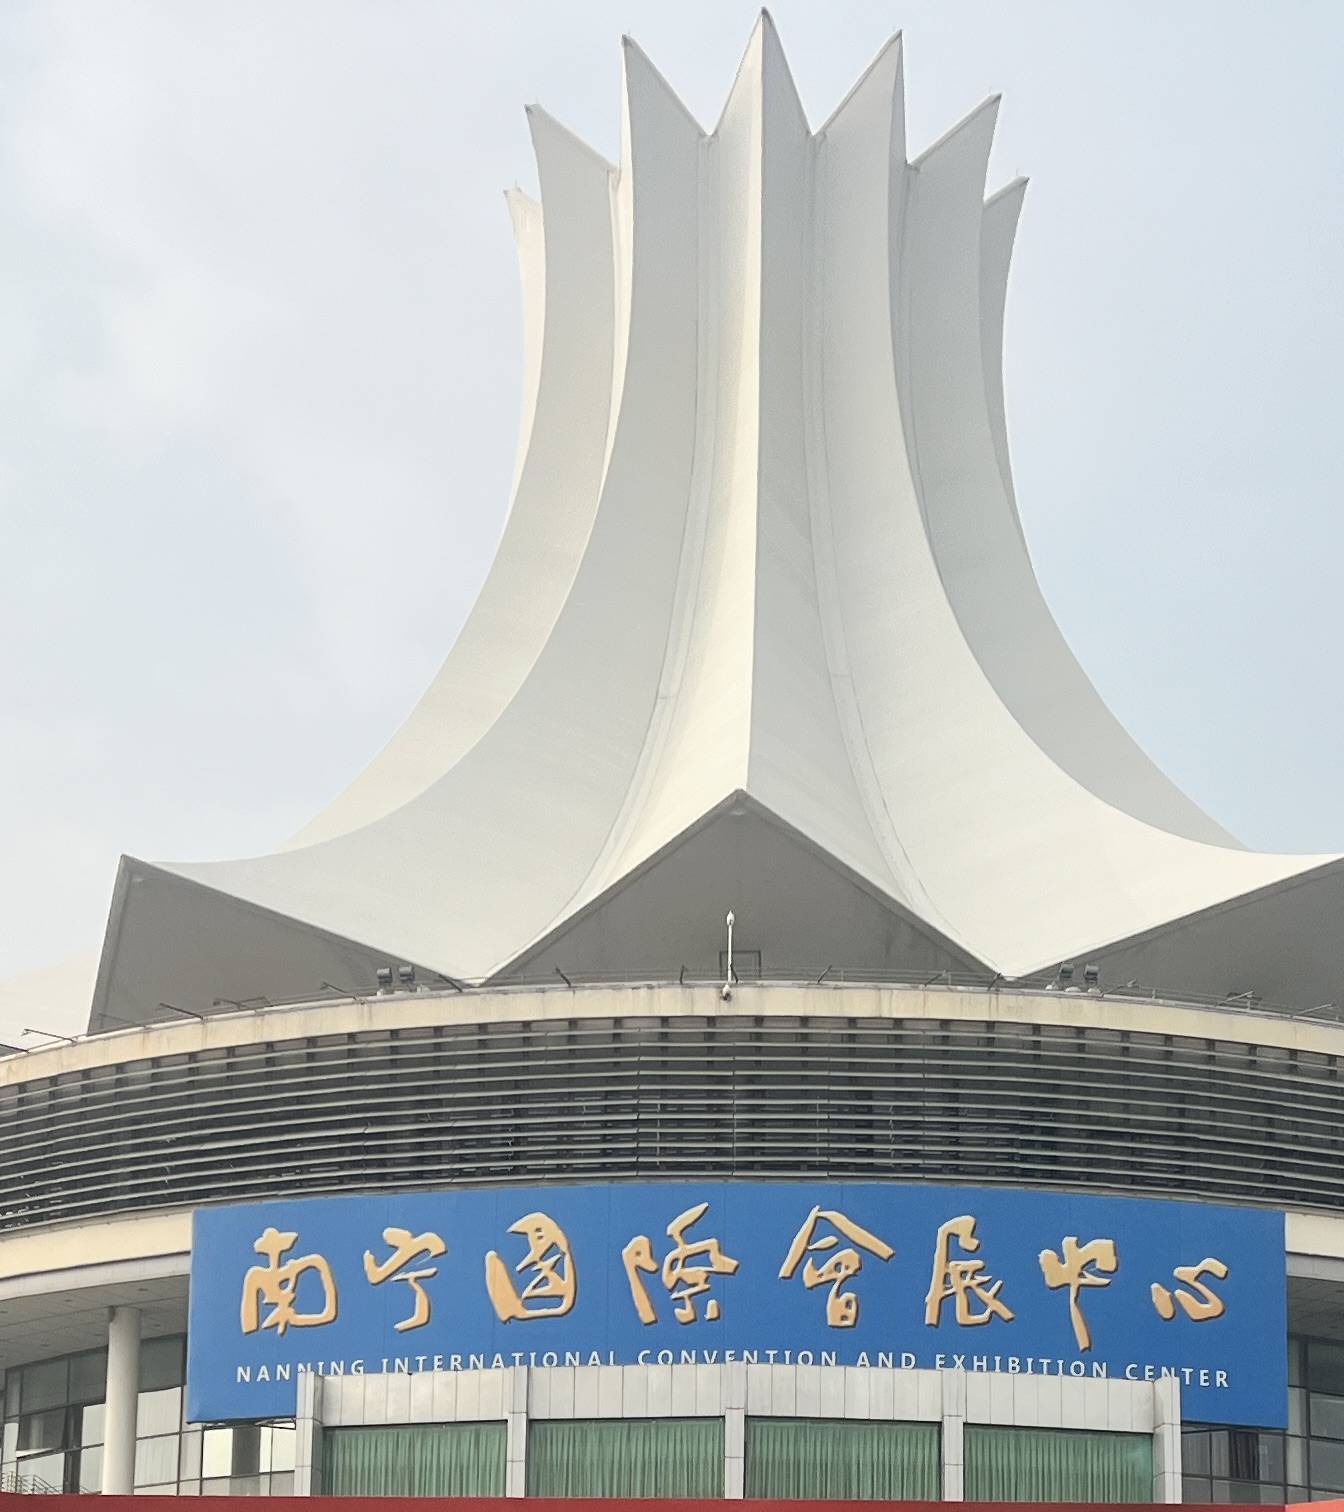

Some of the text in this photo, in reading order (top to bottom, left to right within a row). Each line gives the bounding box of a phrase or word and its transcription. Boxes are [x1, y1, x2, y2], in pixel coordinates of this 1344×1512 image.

[236, 1349, 1230, 1388] NANNING INTERNATIONAL CONVENTION AND EXHIBITION CENTER
